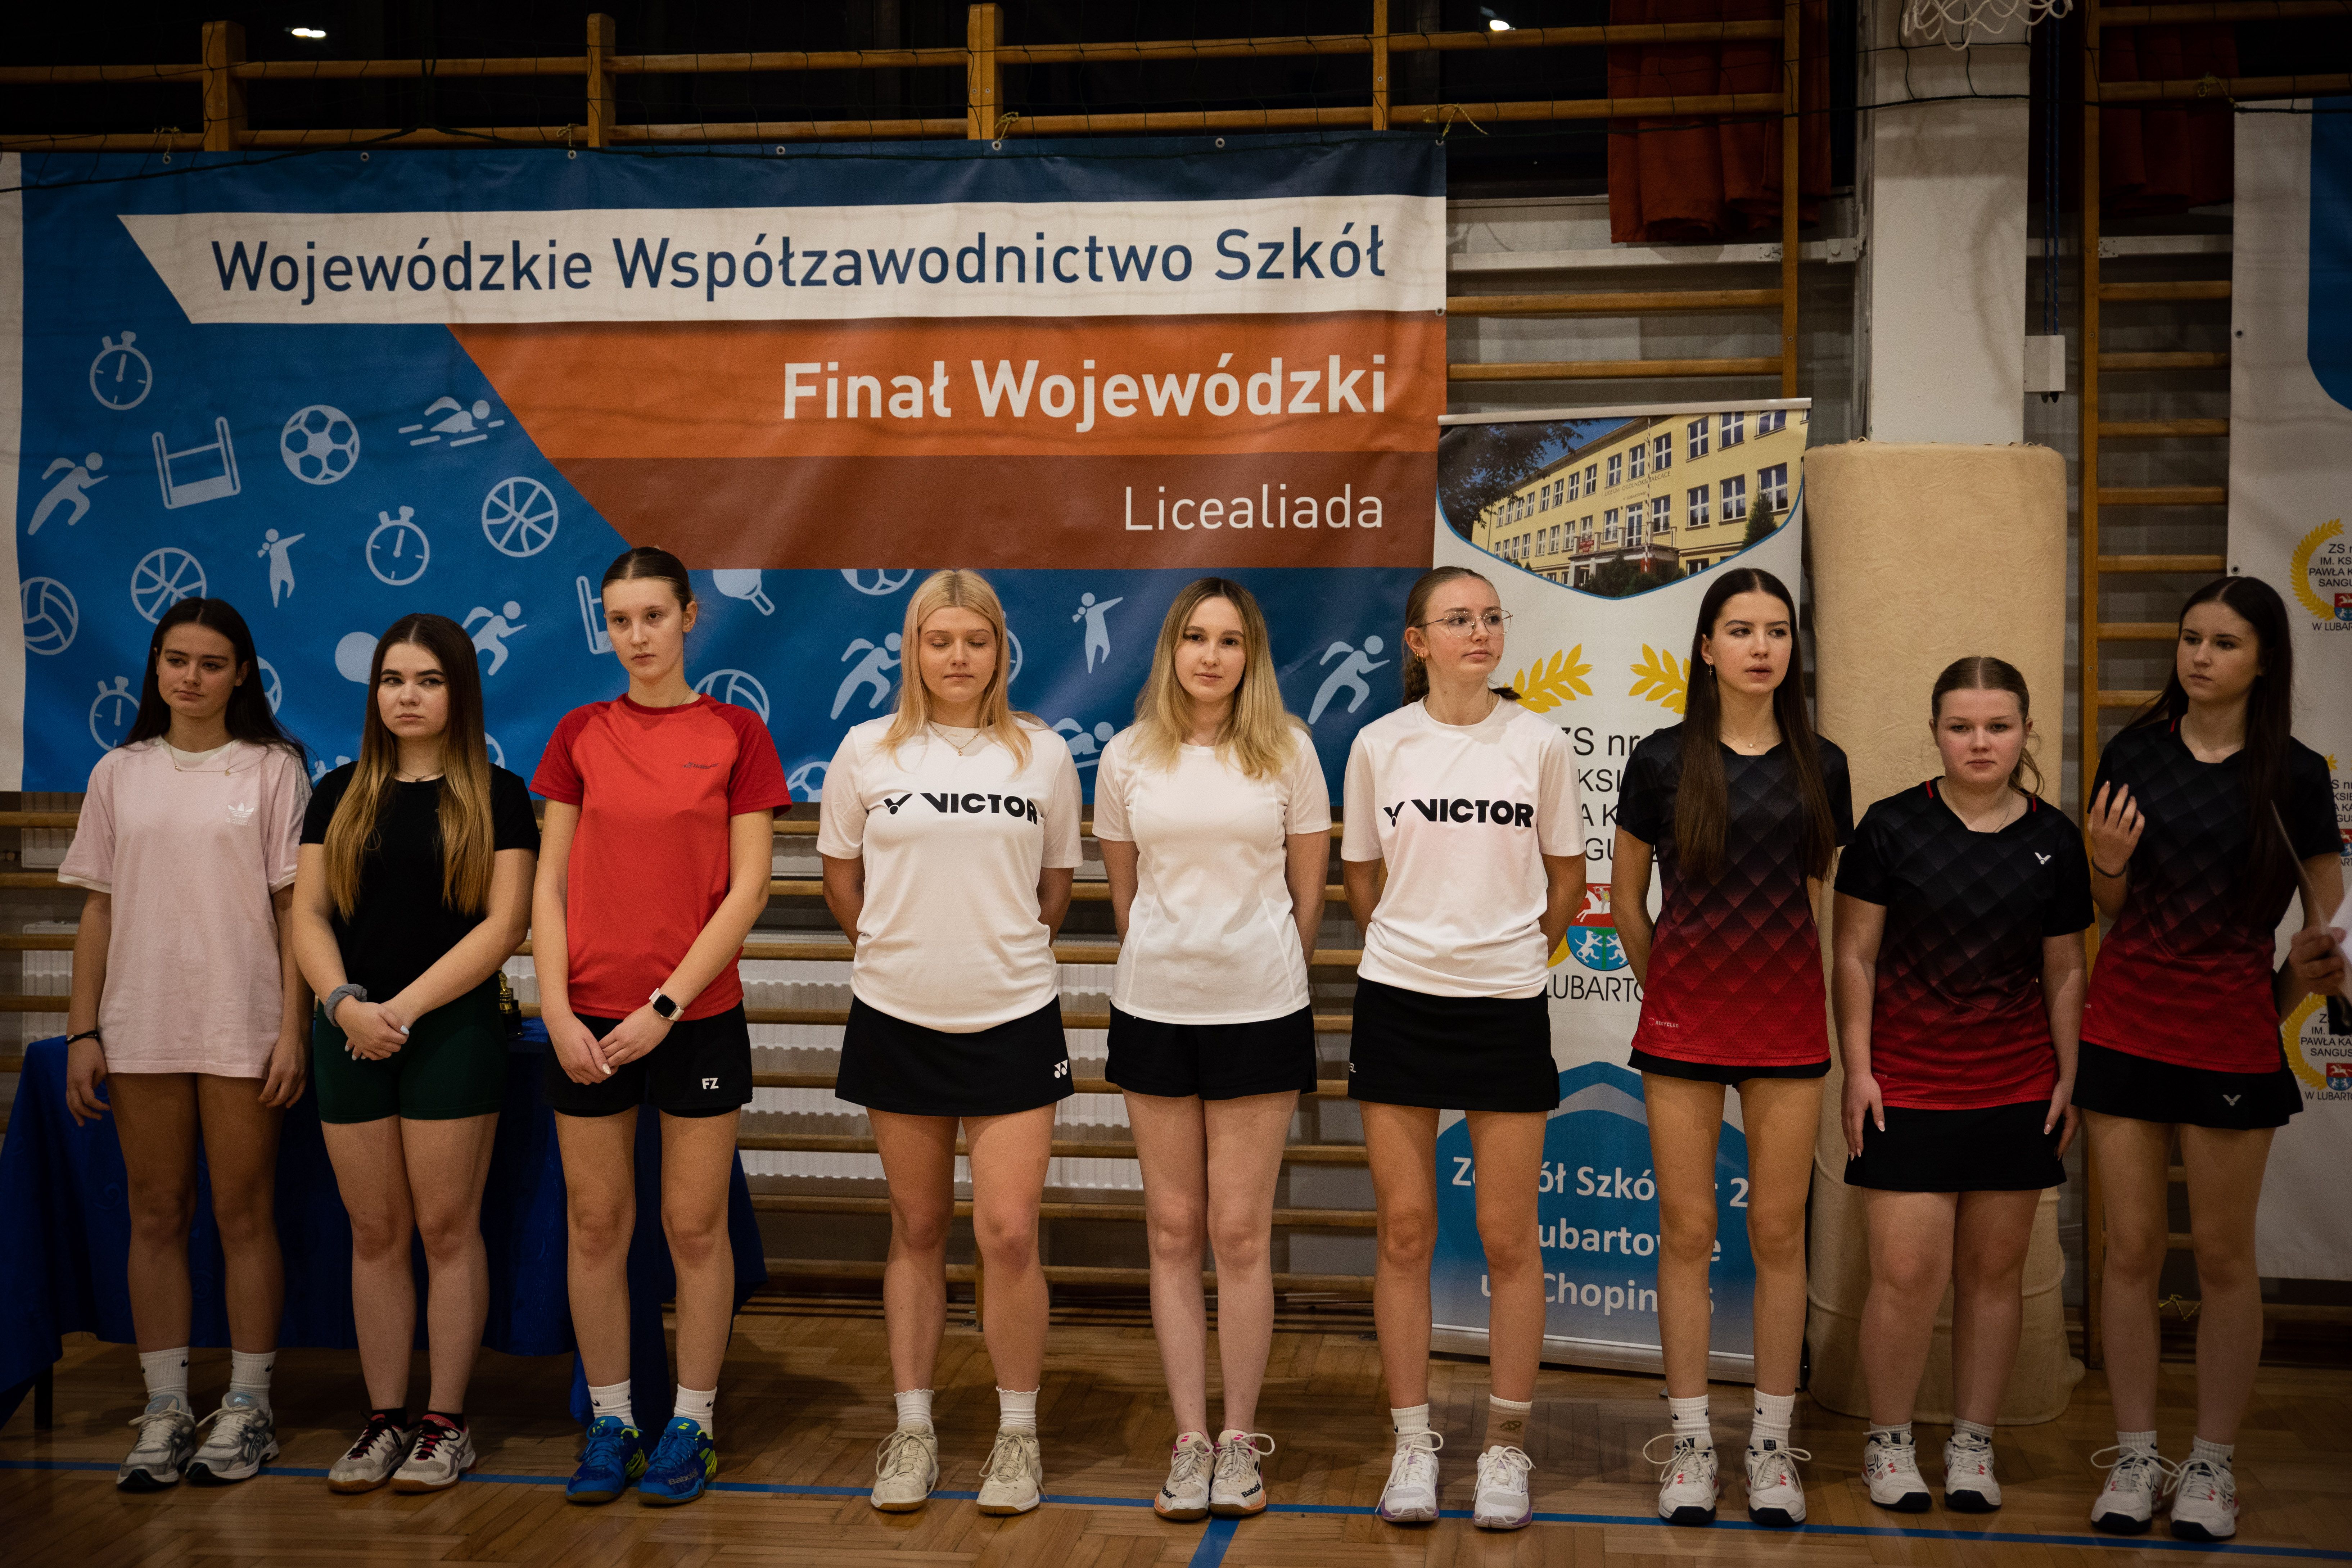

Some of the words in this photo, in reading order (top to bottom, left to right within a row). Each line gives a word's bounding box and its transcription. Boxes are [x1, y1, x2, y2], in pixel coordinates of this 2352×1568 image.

[211, 237, 592, 305] Wojewódzkie
[613, 232, 1193, 302] Współzawodnictwo
[1216, 222, 1385, 281] Szkół
[784, 360, 951, 419] Finał
[971, 353, 1385, 433] Wojewódzki
[1125, 484, 1382, 531] Licealiada
[2328, 544, 2345, 553] ZS
[920, 793, 1037, 825] VICTOR
[1410, 798, 1534, 828] VICTOR
[226, 817, 252, 827] adidas
[1655, 1020, 1679, 1028] RECYCLED
[2301, 1037, 2336, 1045] PAWŁA
[702, 1077, 719, 1090] FZ
[2304, 1091, 2315, 1099] W
[1576, 1166, 1656, 1201] Szkó
